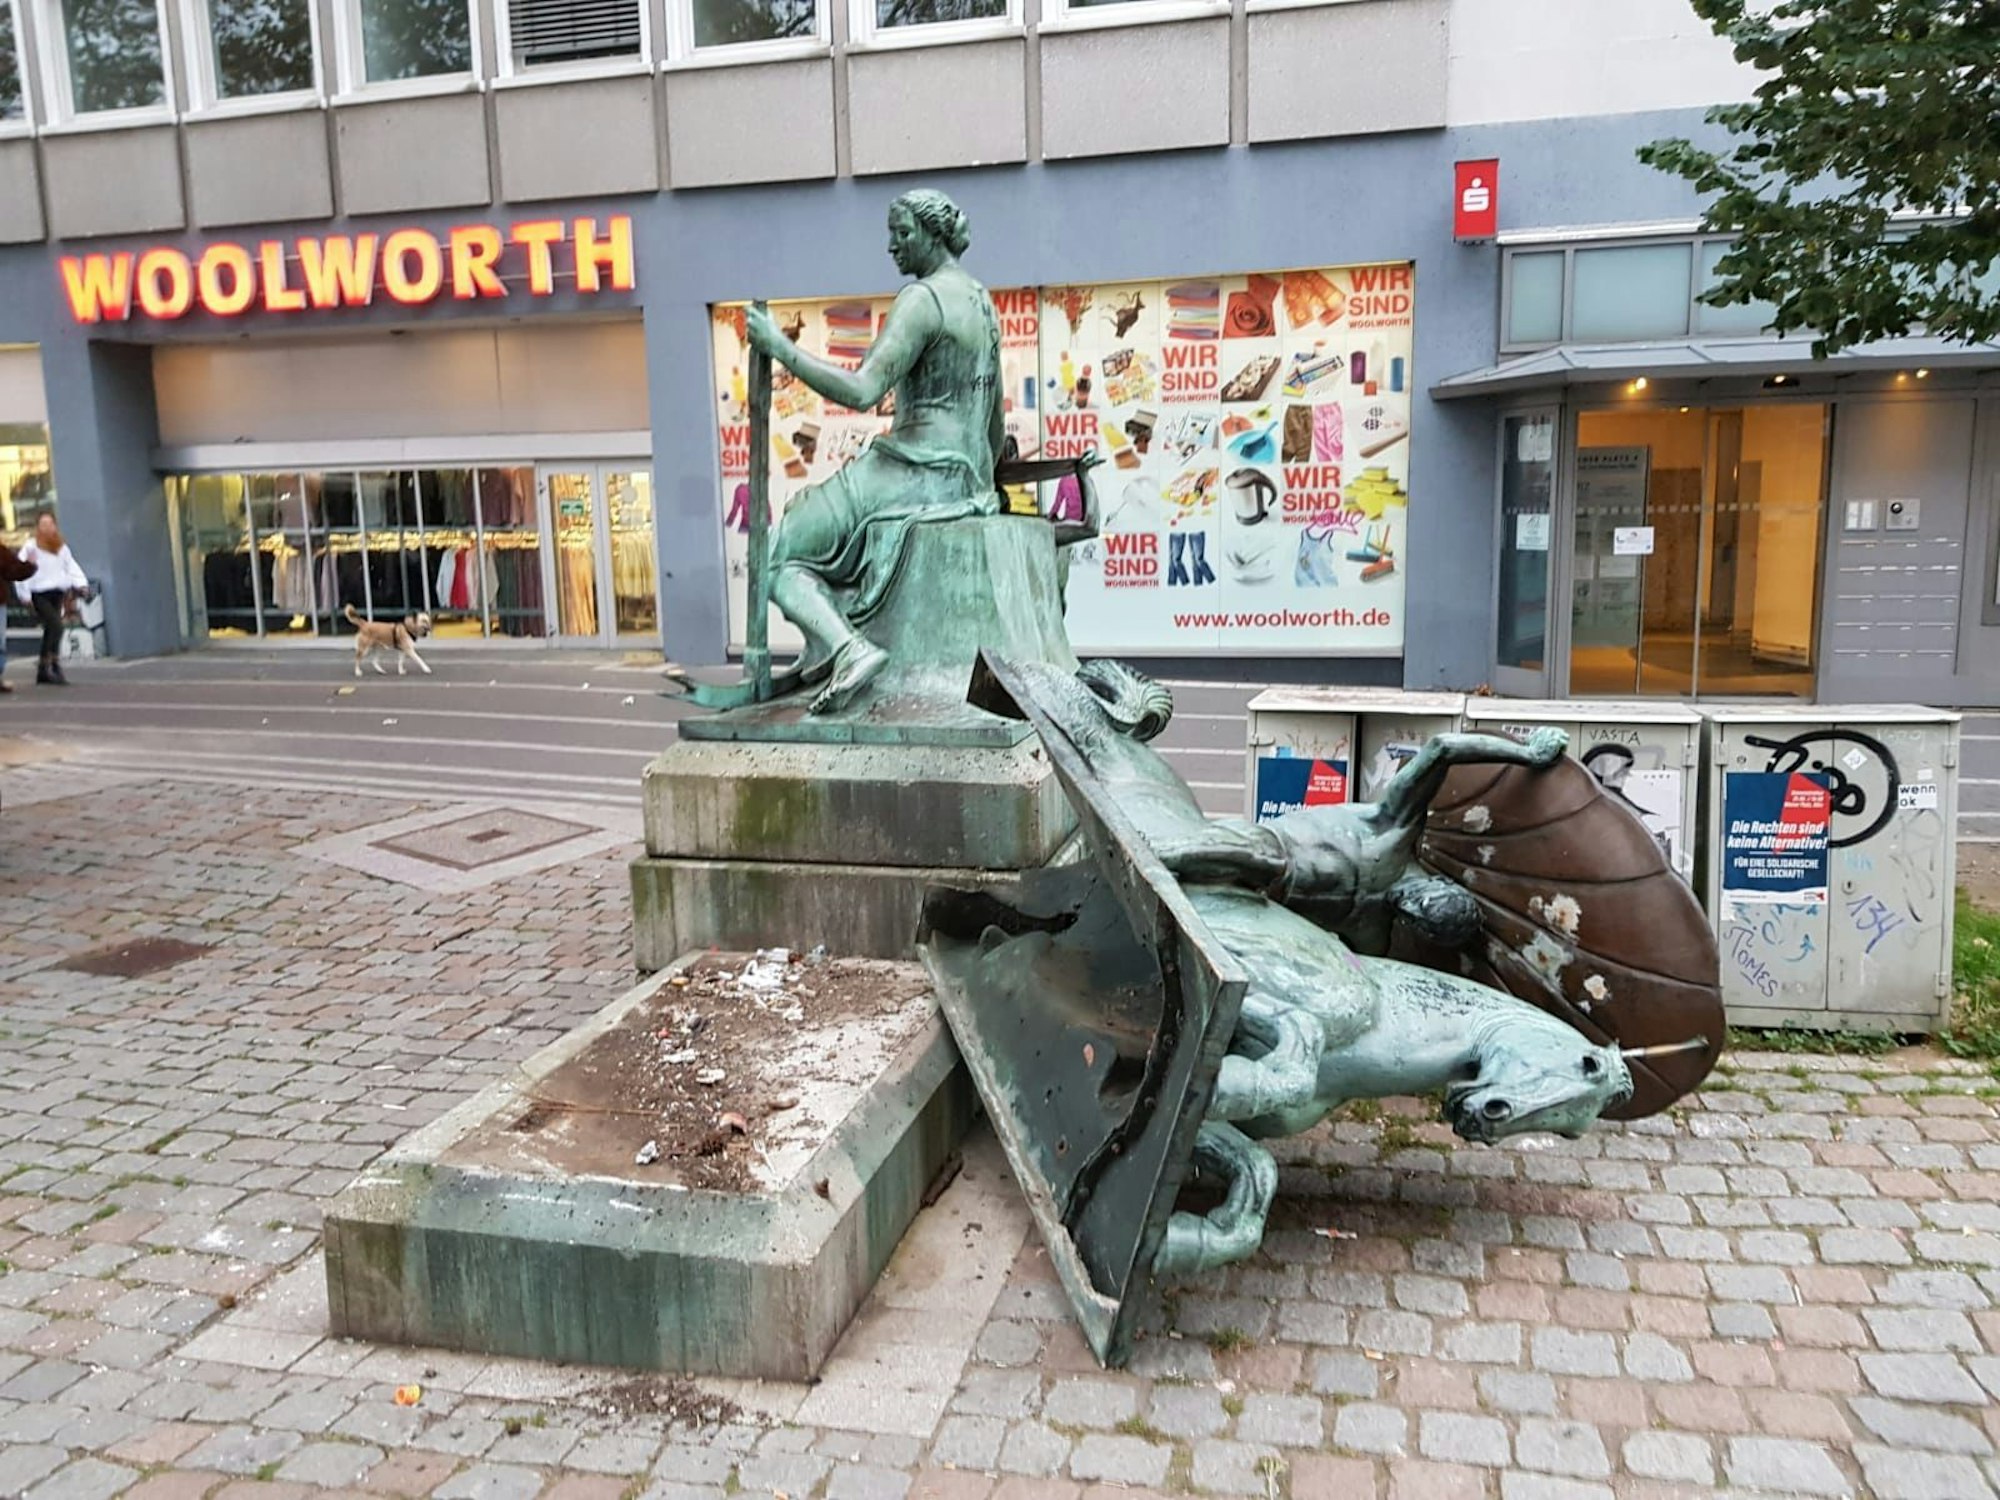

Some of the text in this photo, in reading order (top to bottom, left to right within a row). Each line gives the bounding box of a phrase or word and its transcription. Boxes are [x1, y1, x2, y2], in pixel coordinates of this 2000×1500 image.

[59, 215, 636, 323] WOOLWORTH
[1349, 267, 1409, 293] WIR
[1349, 294, 1409, 316] SIND
[1000, 317, 1038, 337] IND
[1349, 317, 1410, 329] WOOLWORTH
[1162, 344, 1217, 368] WIR
[1162, 370, 1218, 391] SIND
[1162, 392, 1219, 404] WOOLWORTH
[1046, 413, 1098, 436] WIR
[721, 426, 752, 446] WI
[1283, 466, 1341, 489] WIR
[1283, 491, 1341, 512] SIND
[1105, 533, 1158, 555] WIR
[1104, 558, 1158, 576] SIND
[1173, 608, 1391, 628] www.woolworth.de
[1899, 784, 1936, 795] wenn
[1899, 796, 1917, 807] ok
[1731, 820, 1825, 834] Die Rechten sind
[1727, 835, 1828, 850] keine Alternative!
[1734, 856, 1748, 868] FÜR
[1767, 858, 1819, 869] SOLIDARISCHE
[1747, 868, 1805, 879] GESELLSCHAFT!
